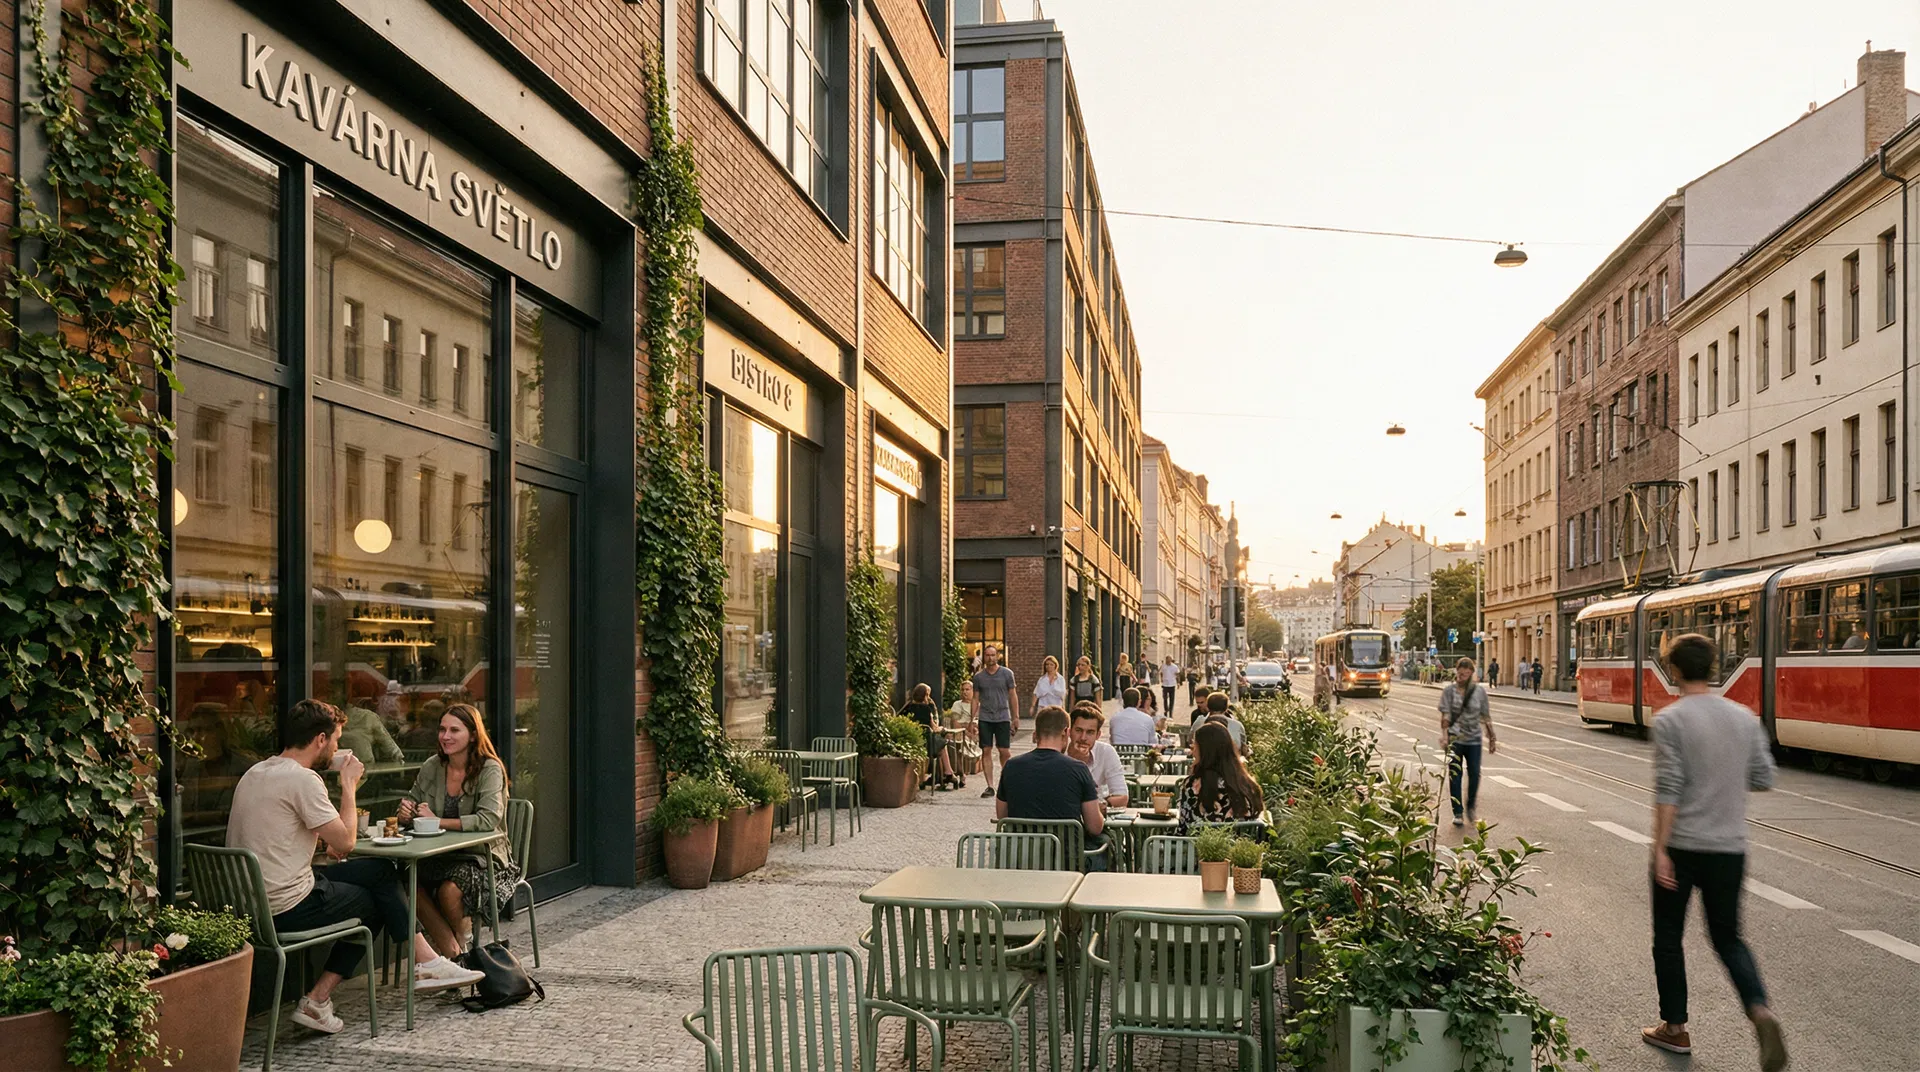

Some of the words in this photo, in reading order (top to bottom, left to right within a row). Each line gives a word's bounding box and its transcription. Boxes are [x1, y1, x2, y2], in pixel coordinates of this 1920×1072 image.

[242, 33, 441, 201] KAVÁRNA
[450, 171, 562, 270] SVĚTLO
[731, 348, 781, 405] BISTRO
